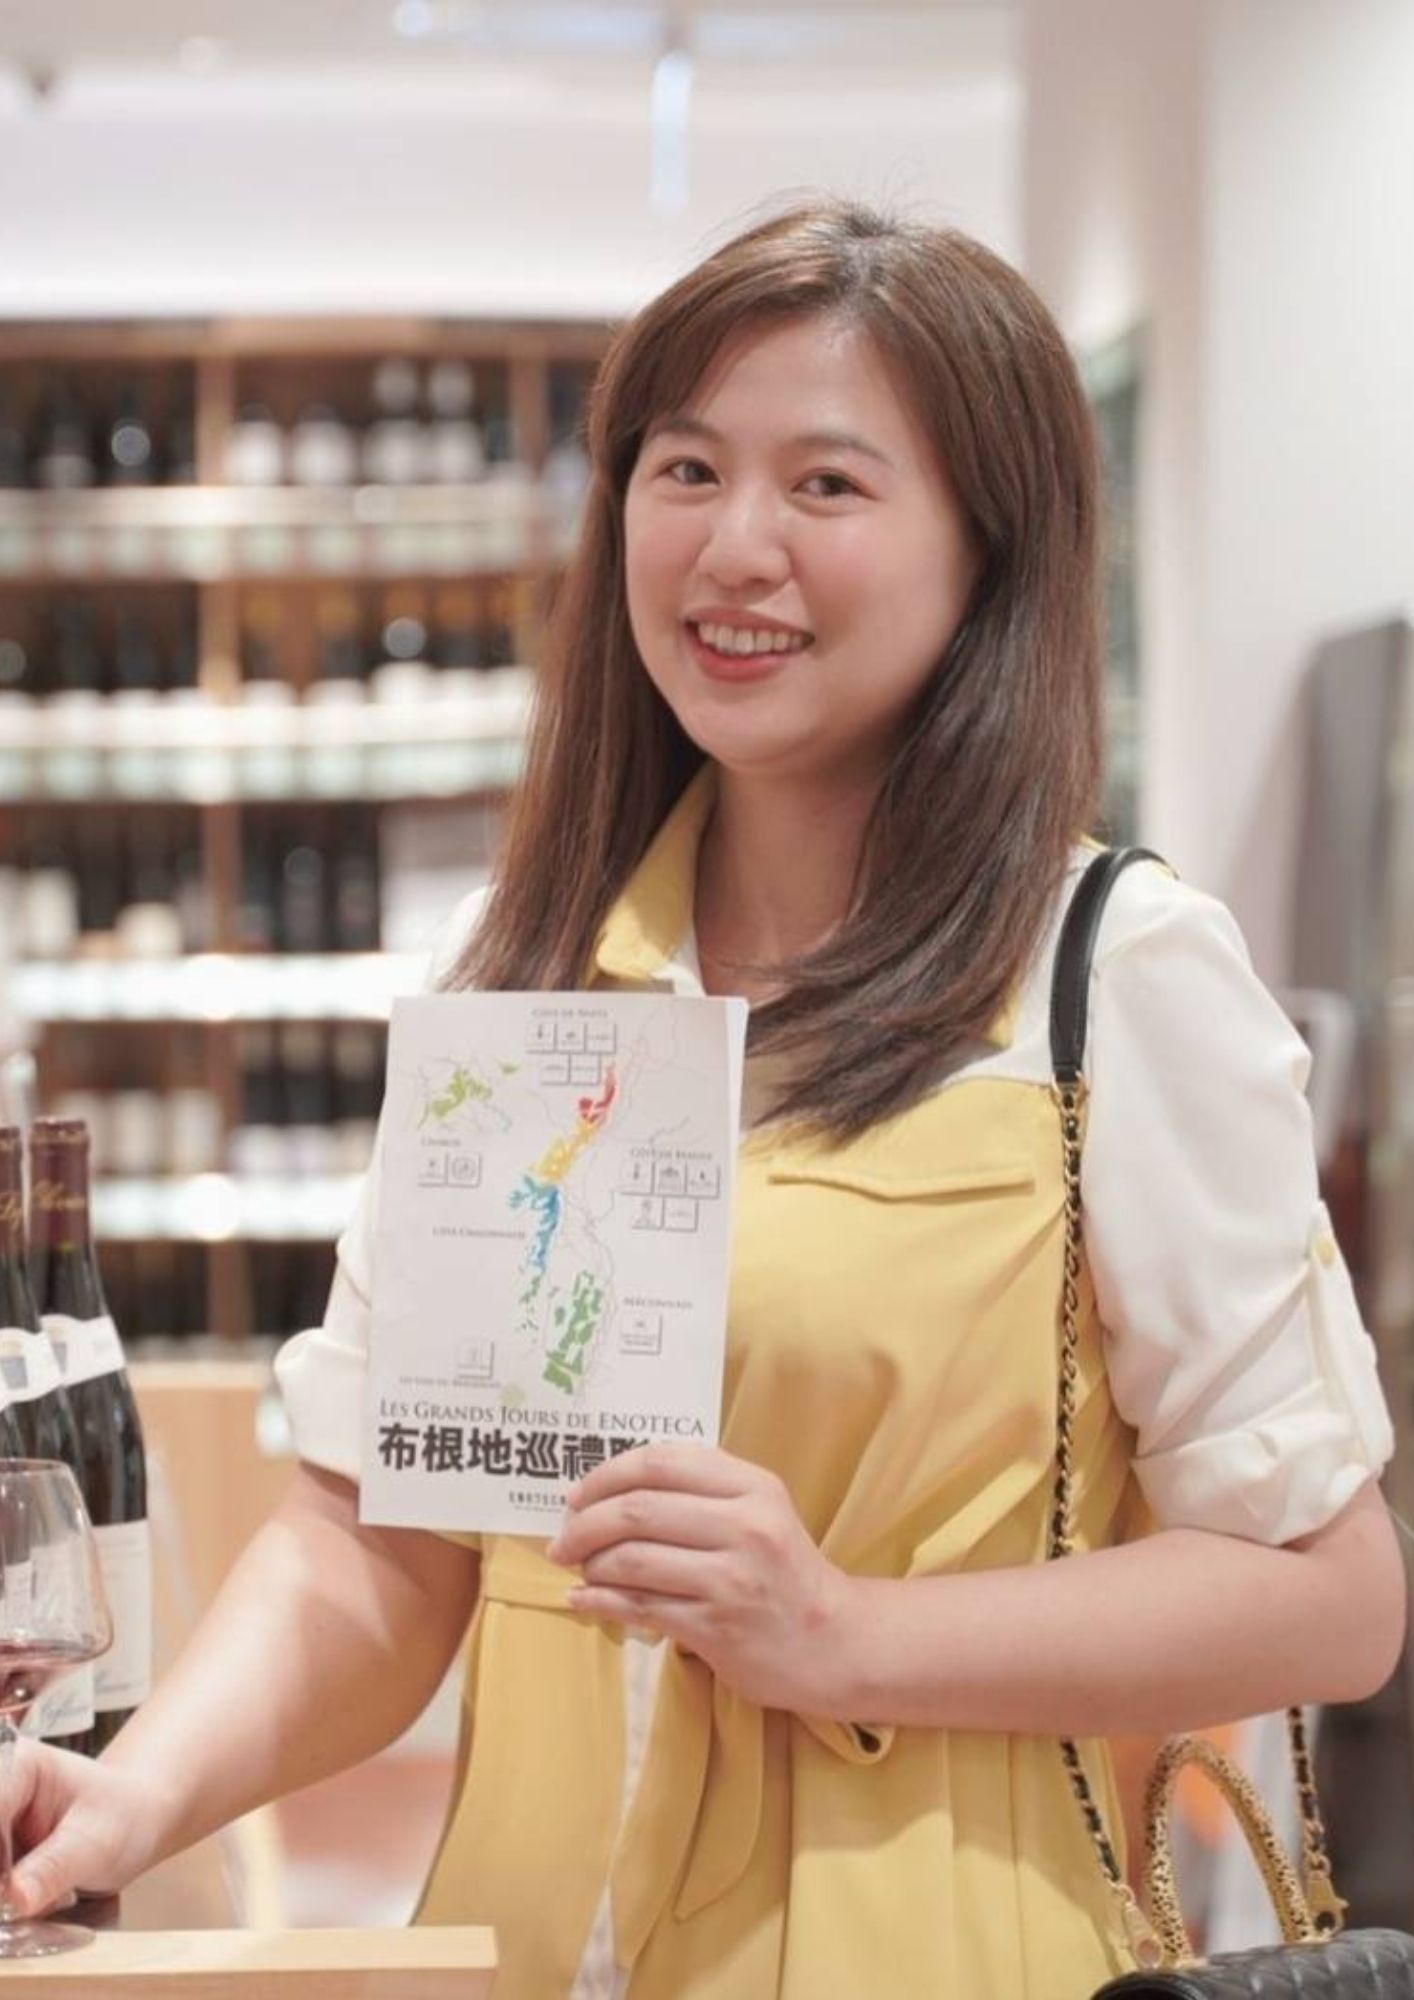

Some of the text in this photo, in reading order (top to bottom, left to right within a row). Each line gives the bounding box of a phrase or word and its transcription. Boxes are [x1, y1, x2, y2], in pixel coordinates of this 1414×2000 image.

[380, 1397, 705, 1437] LES GRANDS JOURS DE ENOTECA
